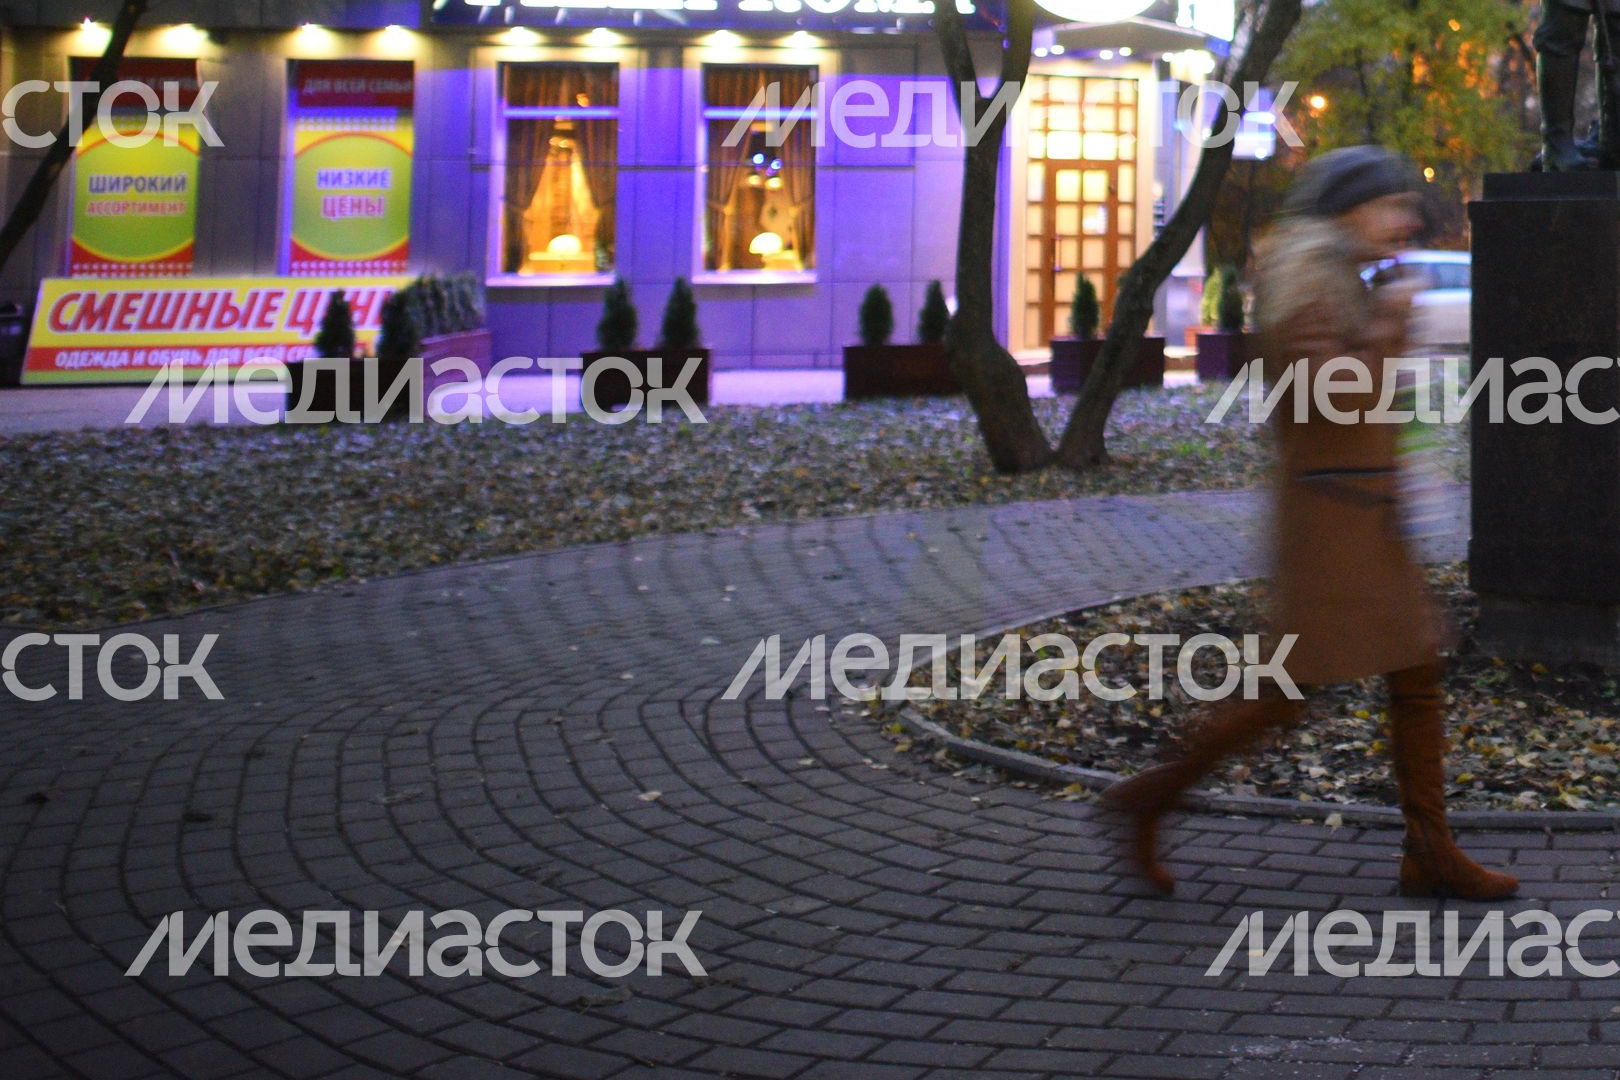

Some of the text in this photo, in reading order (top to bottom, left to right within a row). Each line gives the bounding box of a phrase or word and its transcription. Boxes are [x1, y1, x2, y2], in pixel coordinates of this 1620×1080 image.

[88, 171, 187, 194] ШИРОКИЙ
[317, 169, 392, 190] НИЗКИЕ
[86, 200, 187, 216] АССОРТИМЕНТ
[322, 195, 386, 221] ЦЕНЫ
[49, 289, 285, 332] СМЕШНЫЕ
[55, 349, 129, 368] ОДЕЖДА
[132, 350, 144, 366] И
[147, 348, 201, 367] ОБУВЬ
